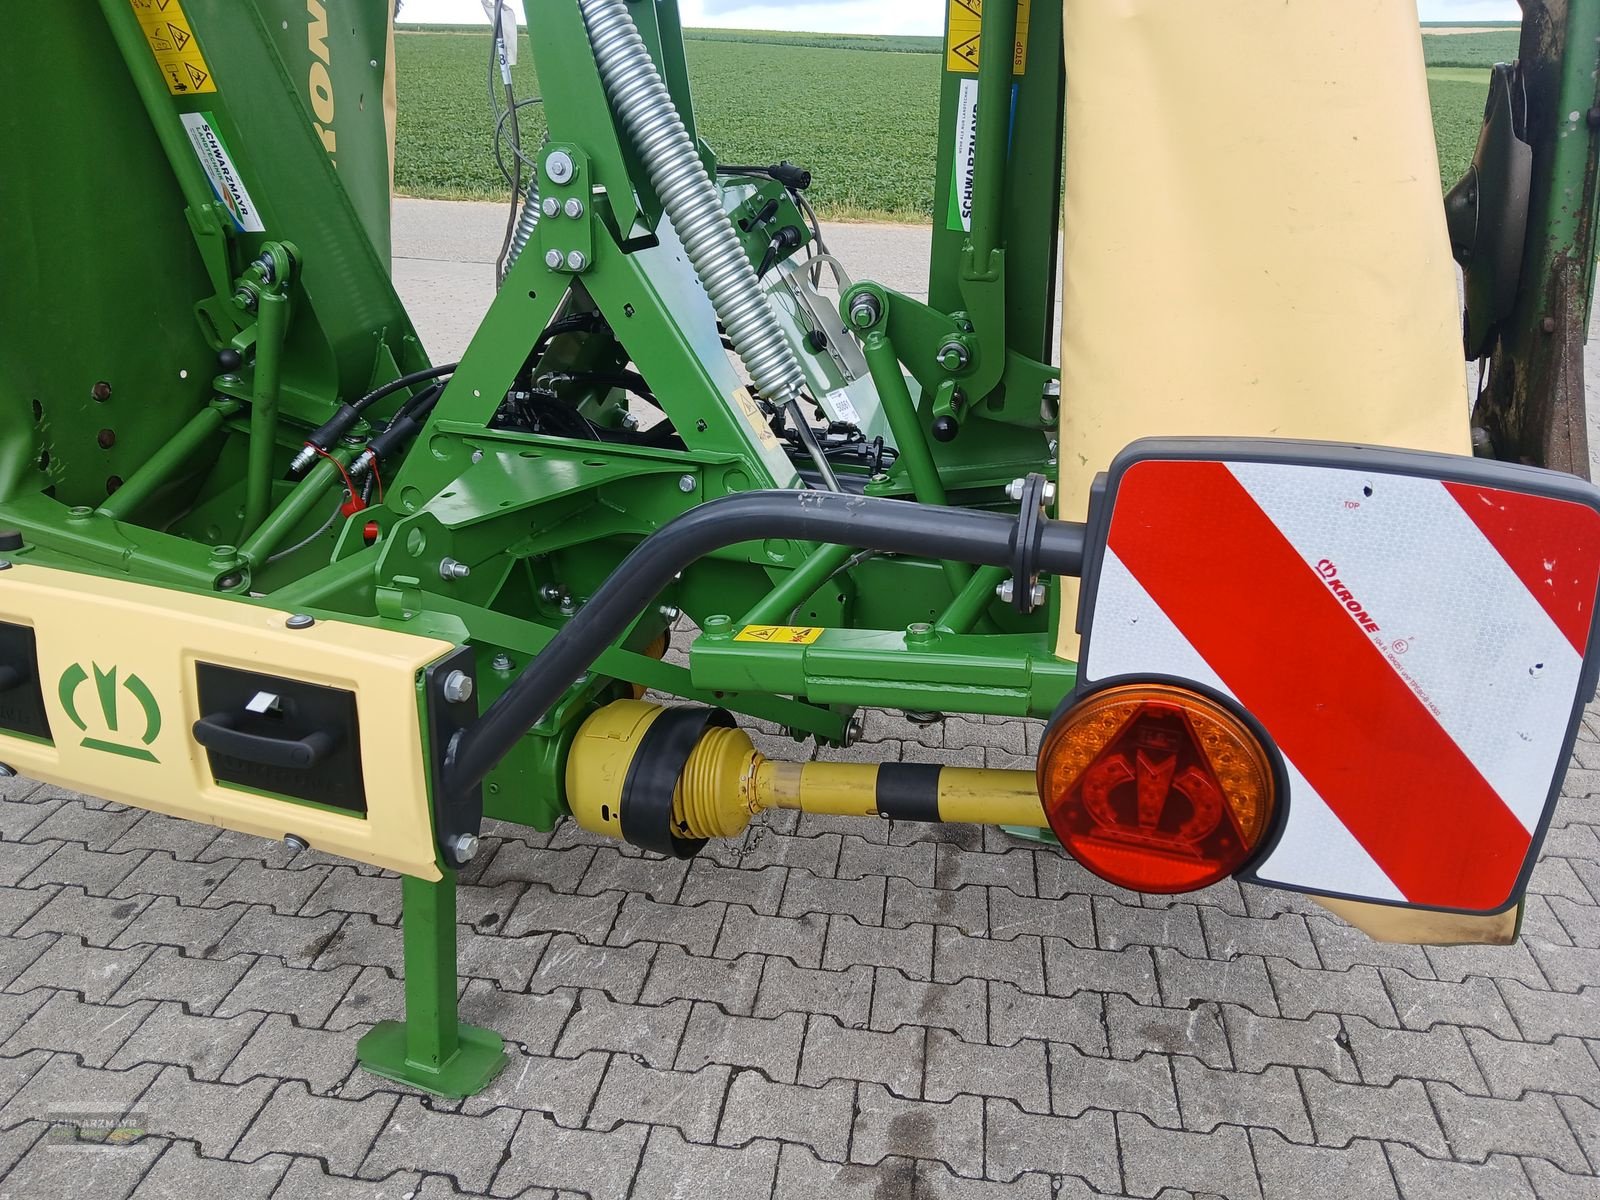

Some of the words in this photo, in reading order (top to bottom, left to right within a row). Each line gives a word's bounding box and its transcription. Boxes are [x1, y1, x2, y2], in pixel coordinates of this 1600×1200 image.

[1015, 41, 1024, 66] STOP
[195, 126, 225, 181] LANDTECHNIK
[201, 124, 249, 216] SCHWARZMAYR
[1343, 500, 1360, 510] TOP
[1329, 577, 1381, 634] KRONE
